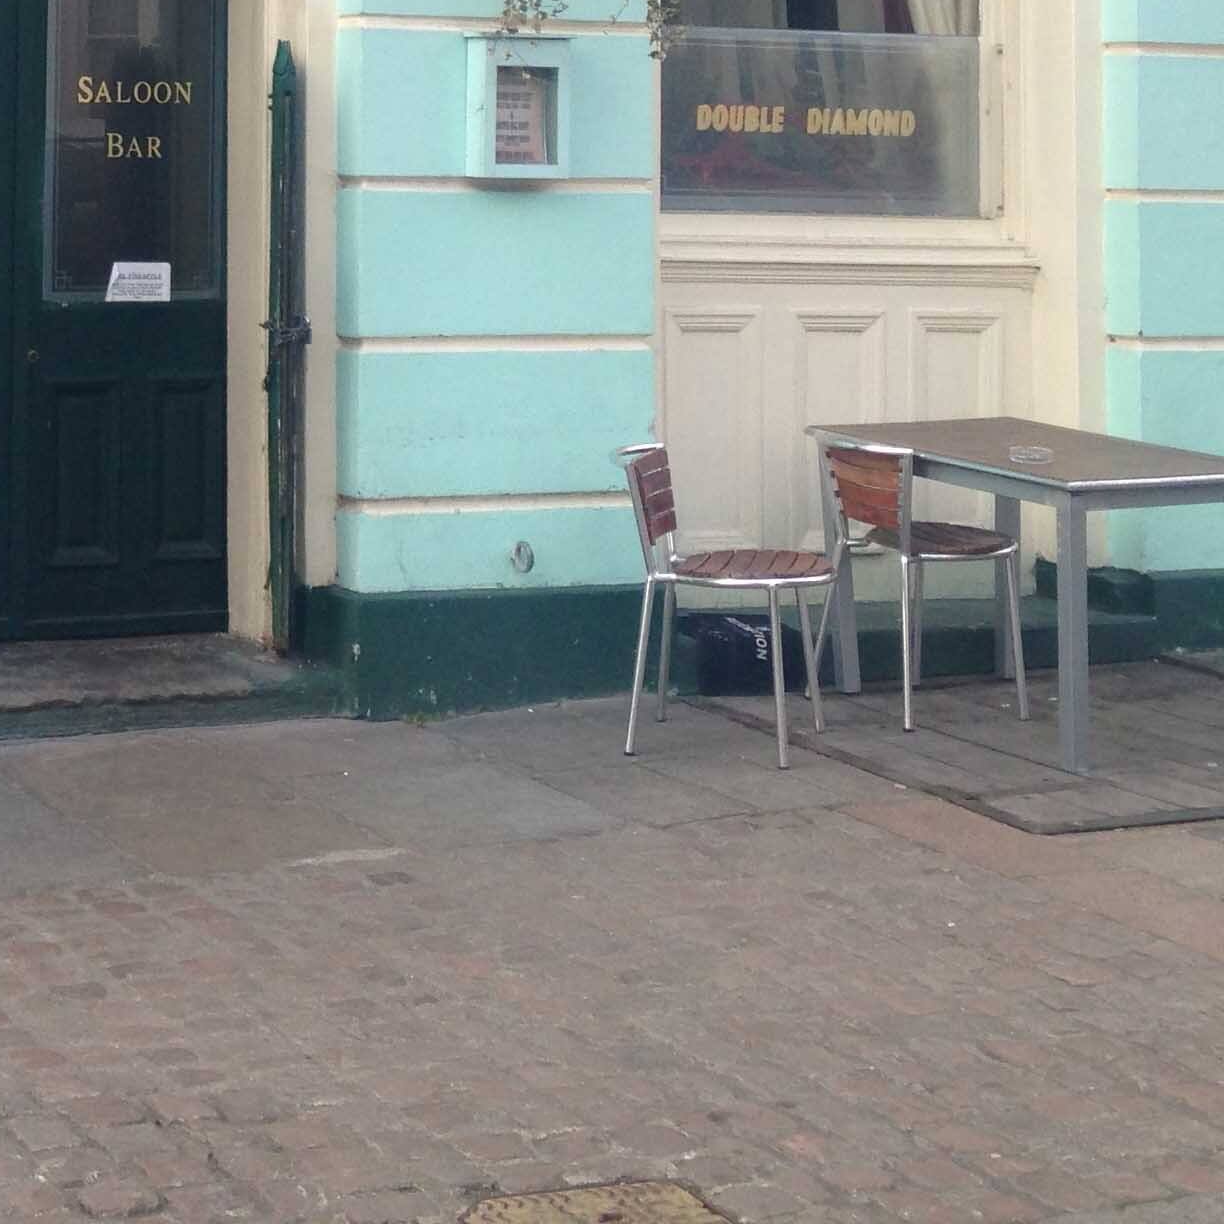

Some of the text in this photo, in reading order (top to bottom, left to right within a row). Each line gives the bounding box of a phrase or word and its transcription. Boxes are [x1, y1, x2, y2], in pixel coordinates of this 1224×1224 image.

[77, 75, 192, 105] SALOON
[695, 103, 916, 137] DOUBLE DIAMOND
[106, 131, 162, 159] BAR
